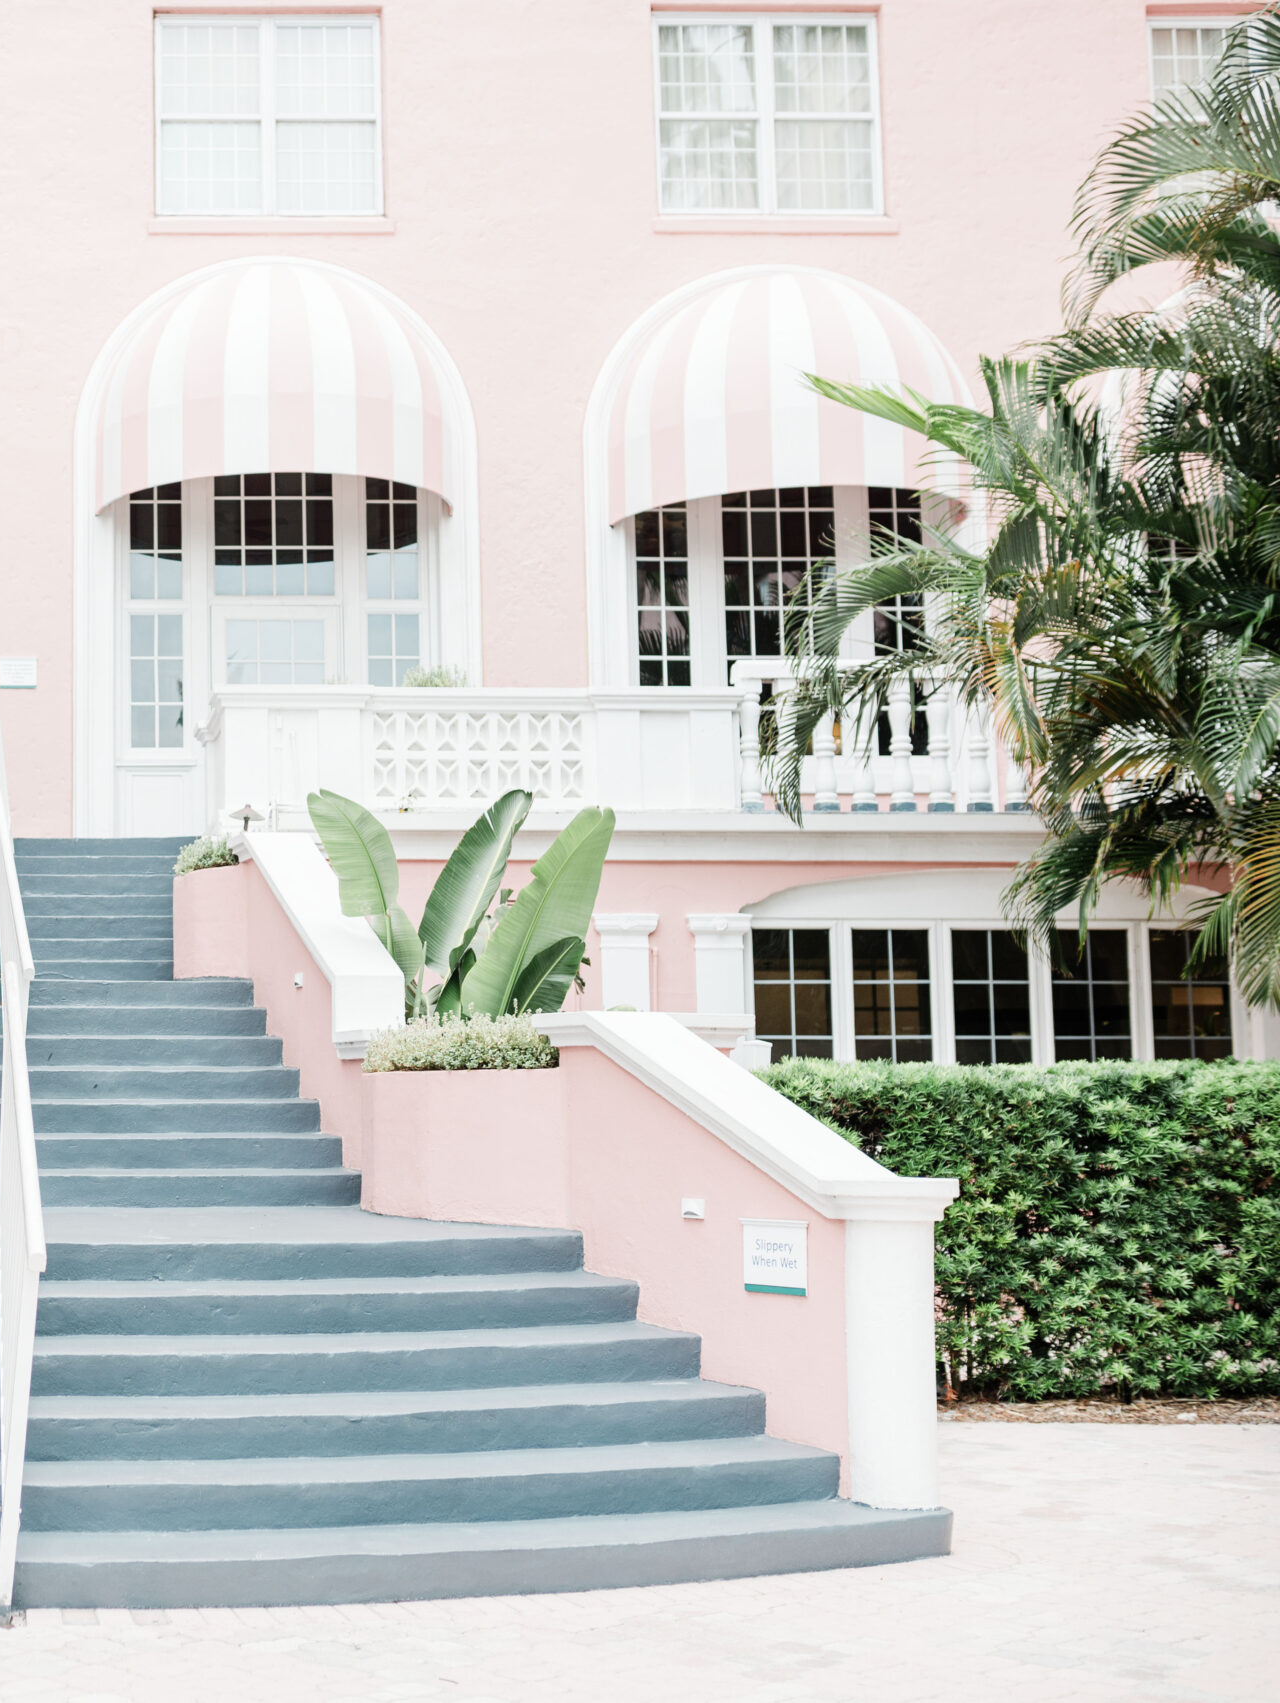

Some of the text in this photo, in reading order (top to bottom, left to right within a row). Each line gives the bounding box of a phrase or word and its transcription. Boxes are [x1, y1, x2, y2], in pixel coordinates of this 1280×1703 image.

[755, 1239, 793, 1254] Slippery
[752, 1255, 798, 1269] When Wet
